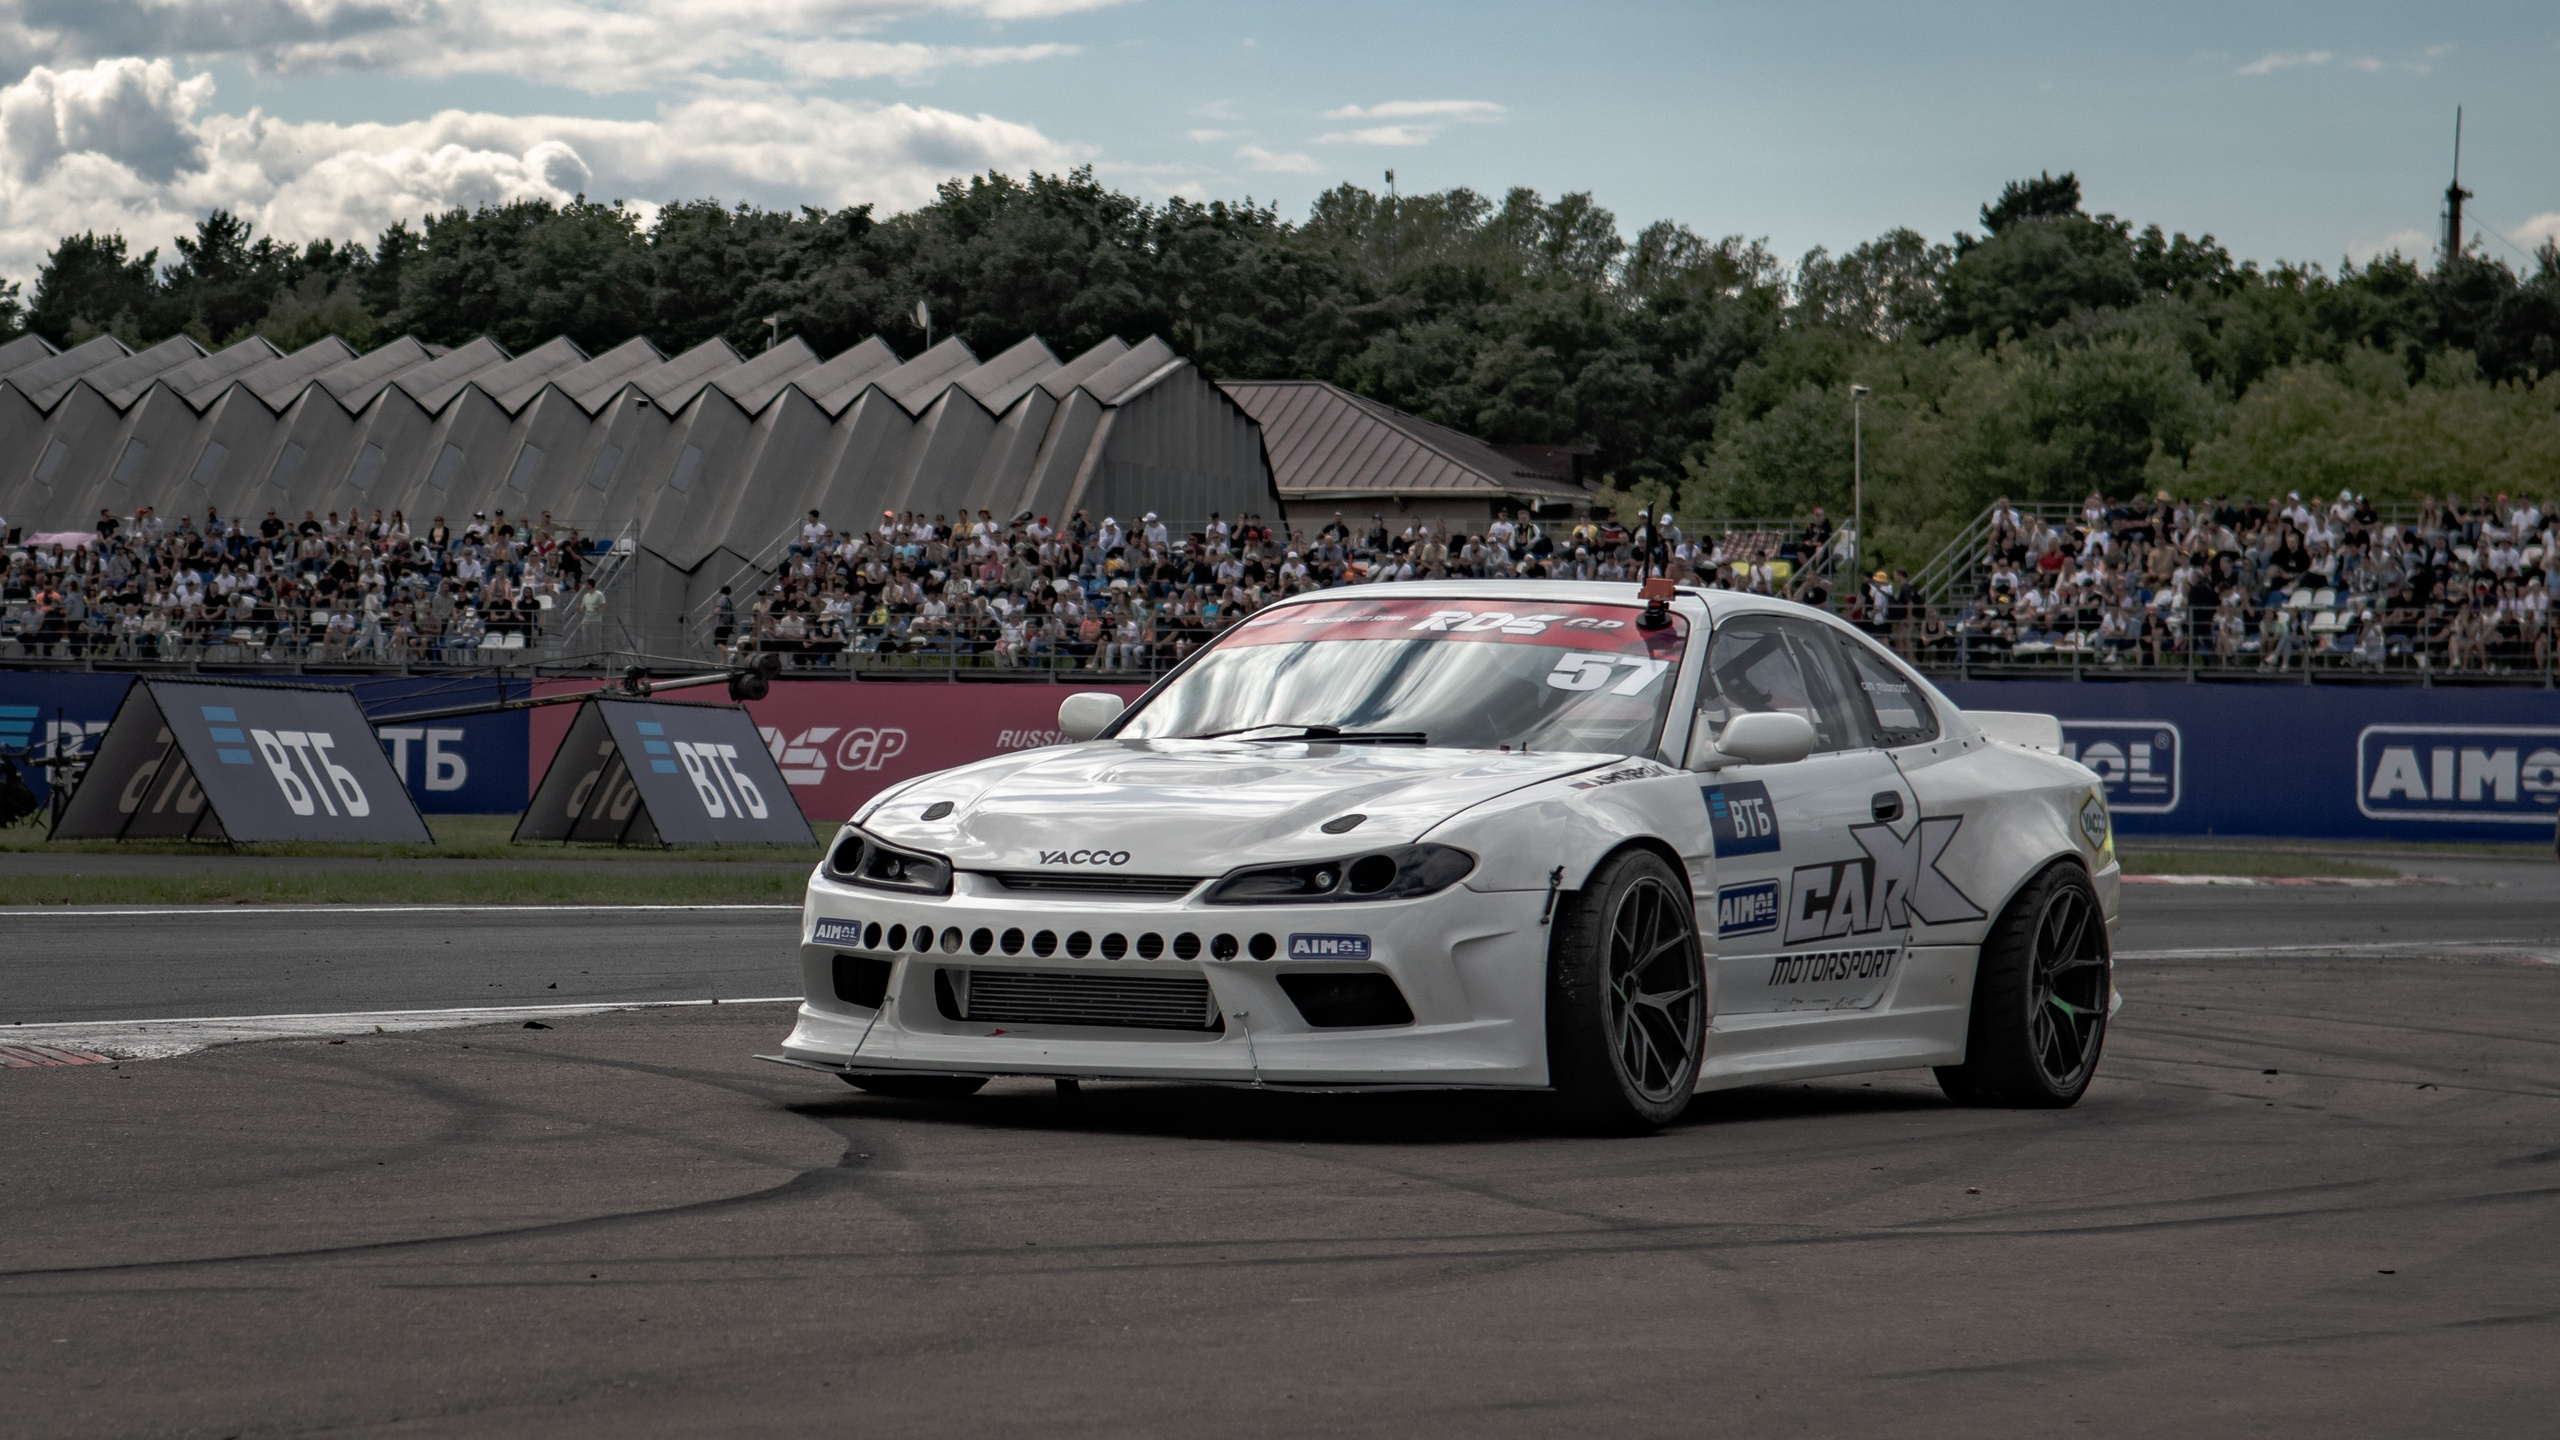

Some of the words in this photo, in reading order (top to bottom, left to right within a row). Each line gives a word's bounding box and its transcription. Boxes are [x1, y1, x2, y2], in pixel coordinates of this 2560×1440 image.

[1409, 611, 1569, 635] RDS
[1563, 617, 1626, 630] GP
[1546, 651, 1670, 698] 57
[836, 727, 907, 771] GP
[249, 728, 370, 818] ВТБ
[674, 741, 769, 820] ВТБ
[1728, 797, 1772, 839] ВТБ
[1038, 849, 1131, 867] YACCO
[1719, 890, 1777, 926] AIMOL
[815, 924, 858, 941] AIMOL
[1292, 939, 1367, 955] AIMOL
[1768, 949, 1897, 986] MOTORSPORT
